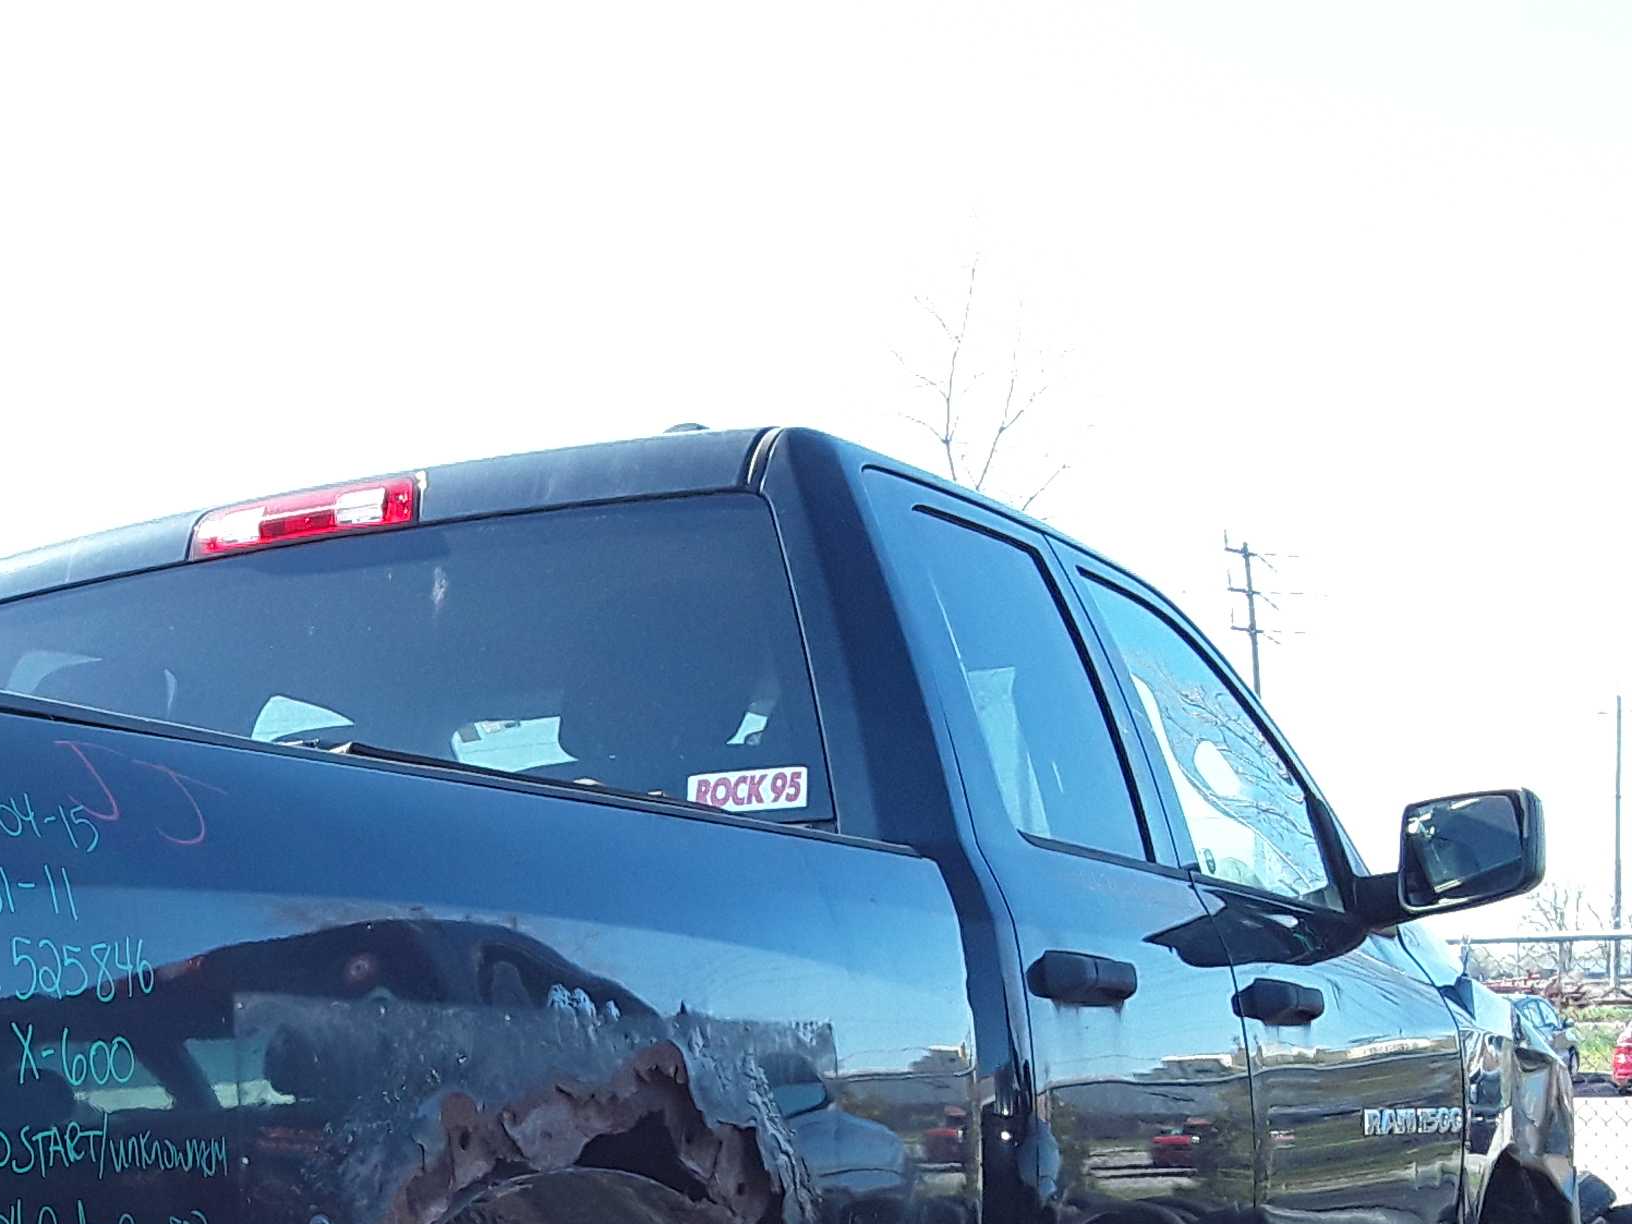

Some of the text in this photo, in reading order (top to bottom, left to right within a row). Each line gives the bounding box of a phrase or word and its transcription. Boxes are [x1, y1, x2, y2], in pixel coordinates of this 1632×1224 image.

[695, 771, 802, 808] ROCK 95
[11, 936, 155, 1001] 525846
[10, 1022, 134, 1085] X-600
[1364, 1107, 1462, 1136] RAM 1500
